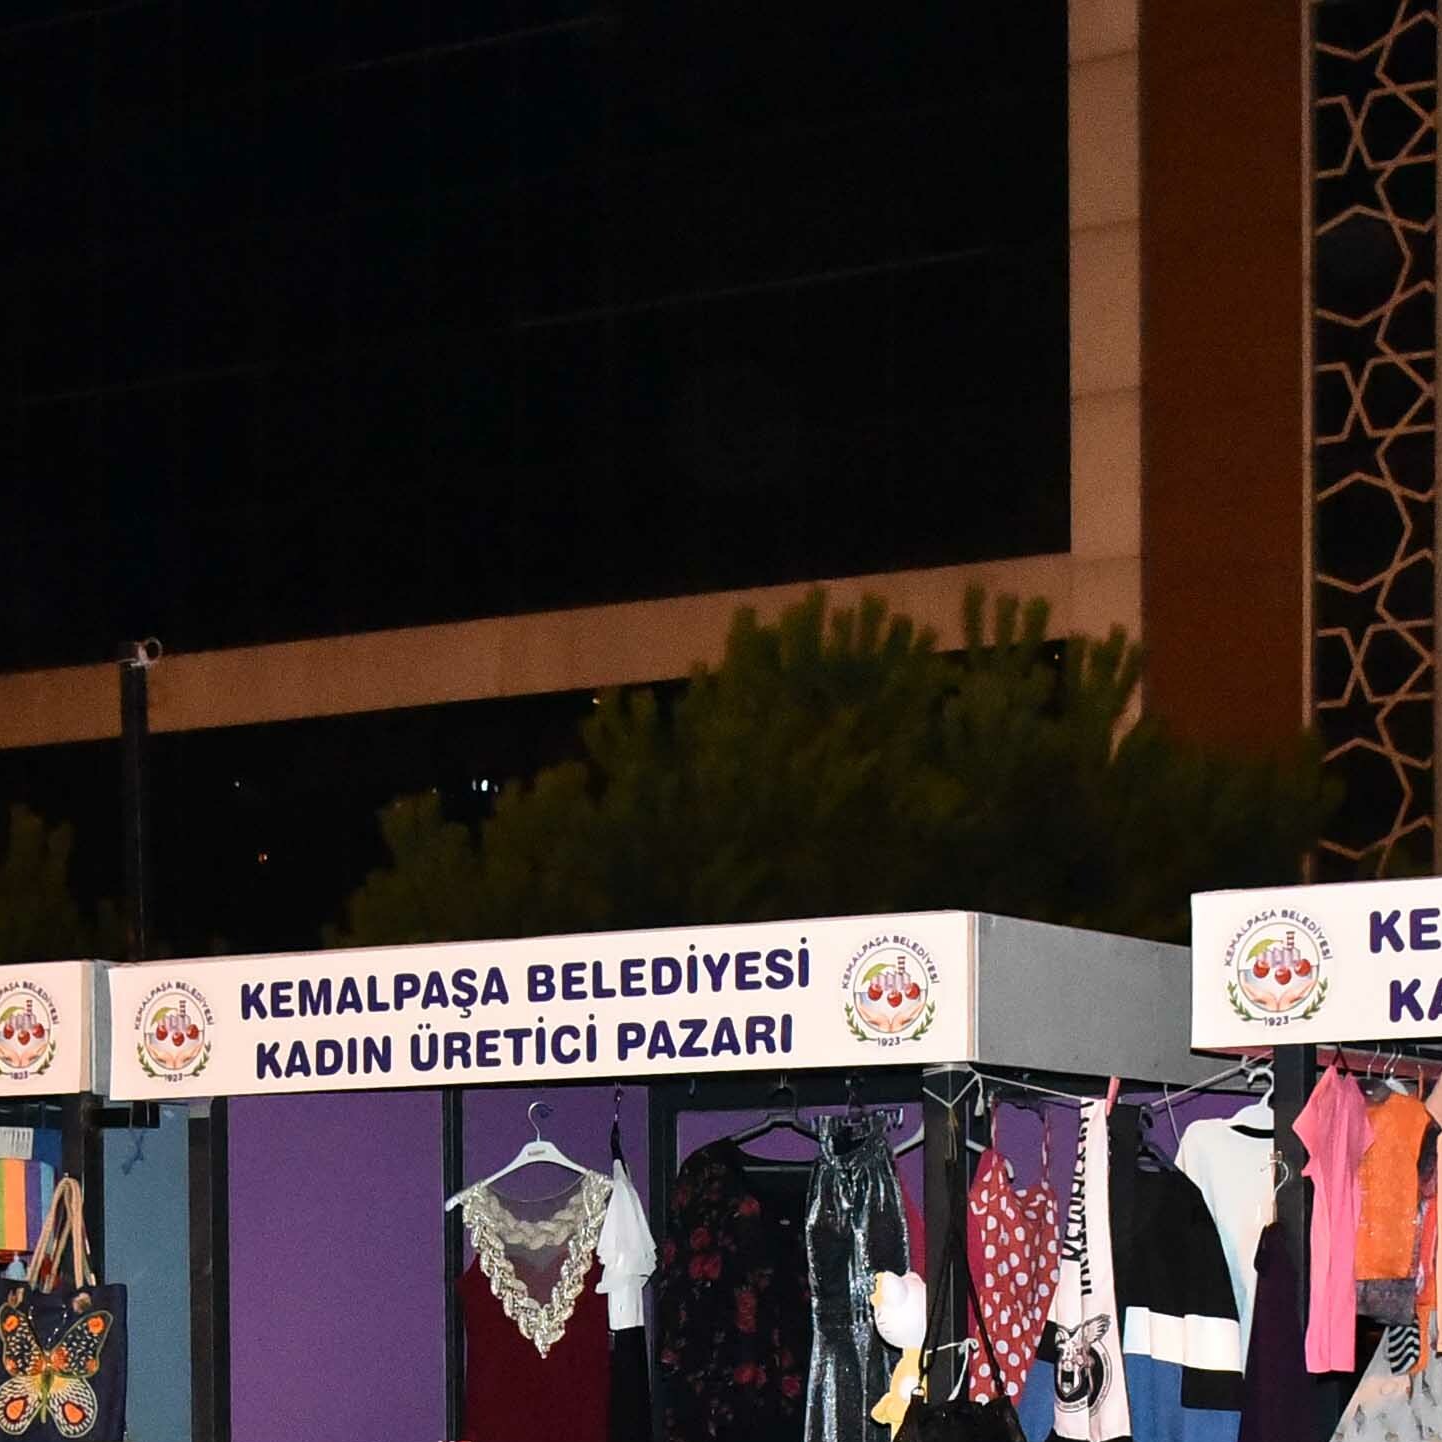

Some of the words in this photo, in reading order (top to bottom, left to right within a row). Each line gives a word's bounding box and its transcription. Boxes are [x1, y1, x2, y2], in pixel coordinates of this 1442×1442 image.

[241, 967, 509, 1020] KEMALPAŞA
[528, 937, 809, 1002] BELEDİYESİ
[257, 1036, 391, 1079] KADIN
[411, 1014, 596, 1071] ÜRETİCİ
[618, 1014, 792, 1061] PAZARI
